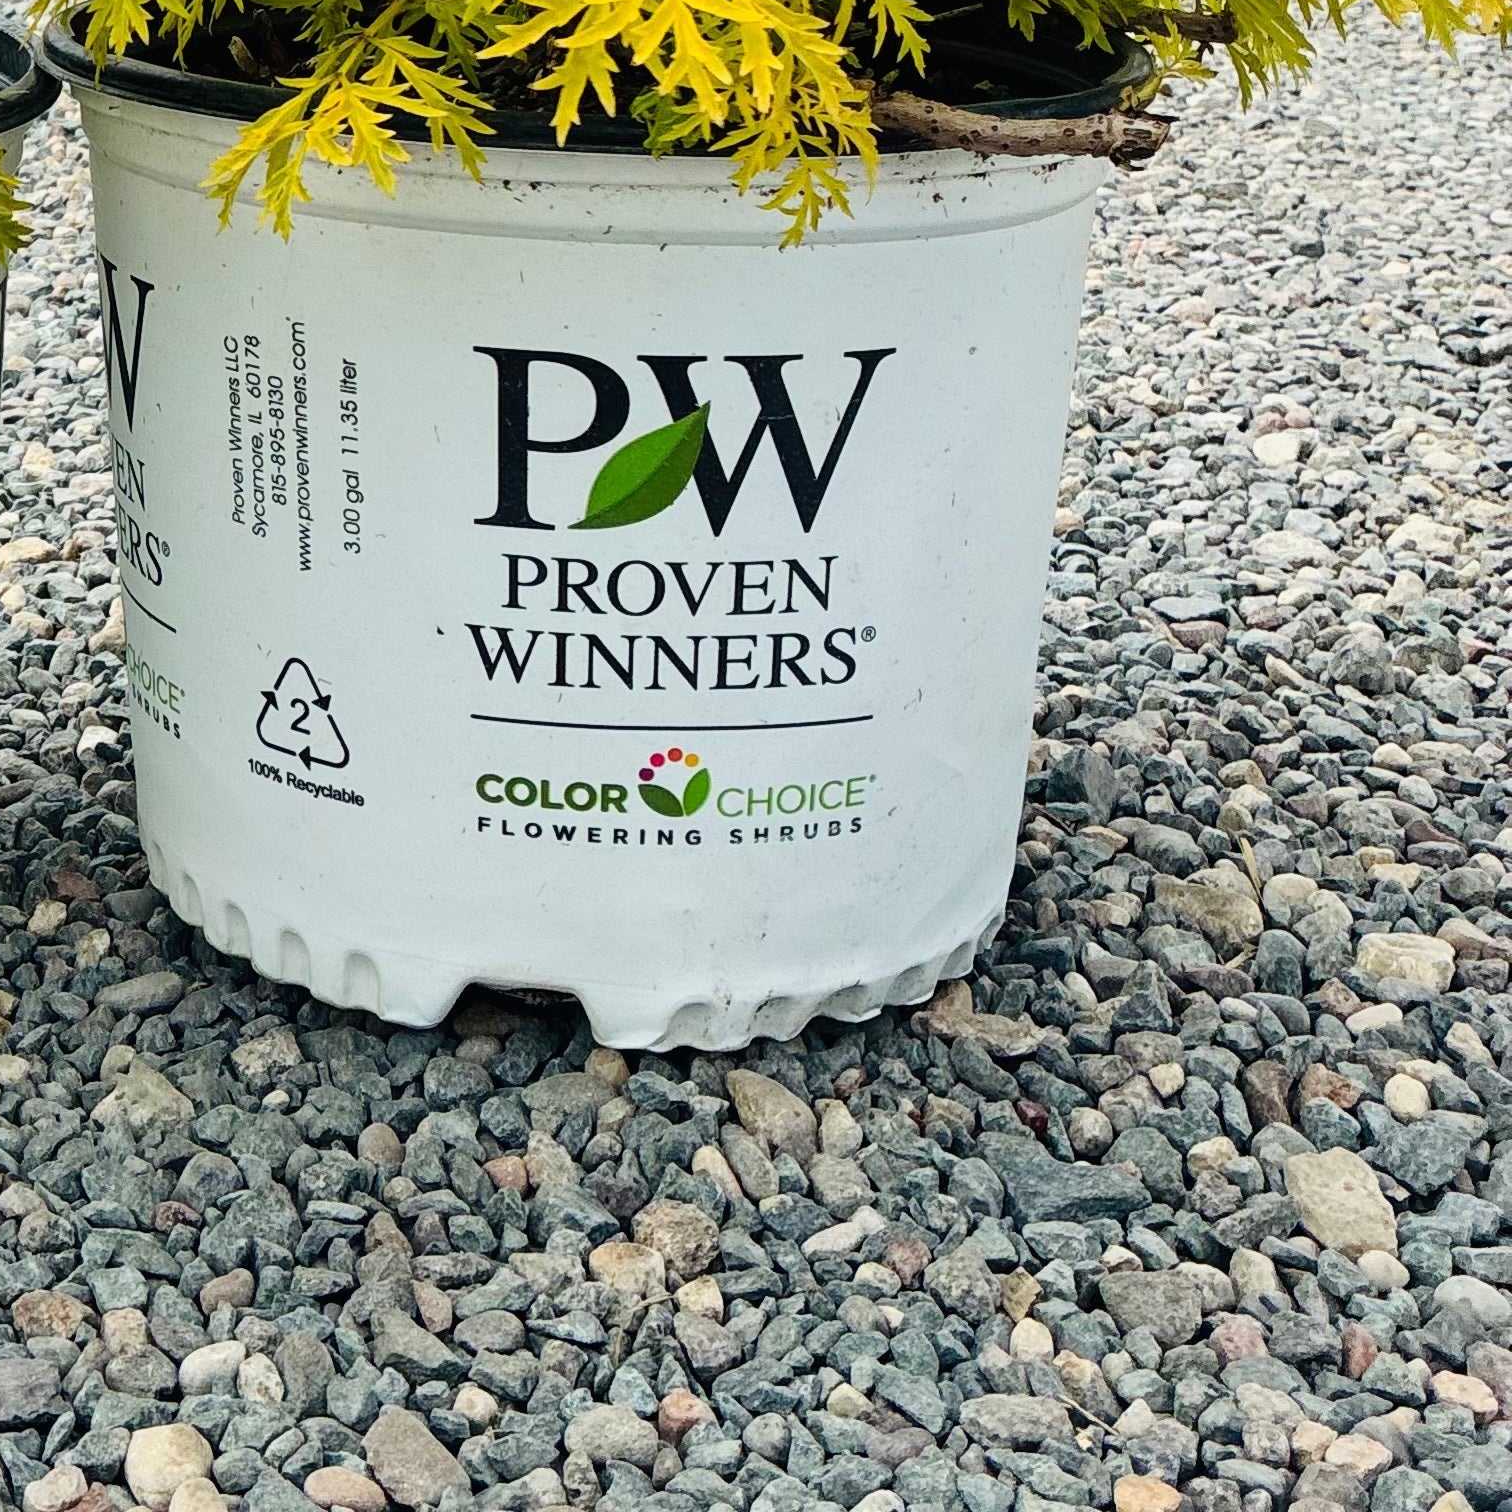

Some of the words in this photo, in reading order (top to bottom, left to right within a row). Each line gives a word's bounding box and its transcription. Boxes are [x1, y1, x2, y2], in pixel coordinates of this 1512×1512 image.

[223, 334, 240, 373] LLC
[243, 334, 262, 400] 60178
[340, 357, 359, 395] liter
[228, 376, 243, 452] Winners
[247, 410, 263, 425] IL
[267, 374, 287, 506] 815-895-8130
[340, 399, 360, 455] 11.35
[472, 345, 897, 537] PW
[291, 321, 314, 572] www.provenwinners.com
[231, 457, 246, 526] Proven
[251, 431, 269, 538] Sycamore,
[342, 469, 364, 504] gal
[343, 507, 361, 555] 3.00
[500, 553, 839, 617] PROVEN
[247, 757, 284, 785] 100%
[286, 771, 366, 807] Recyclable
[476, 773, 628, 814] COLOR
[476, 816, 702, 846] FLOWERING
[729, 817, 863, 845] SHRUBS
